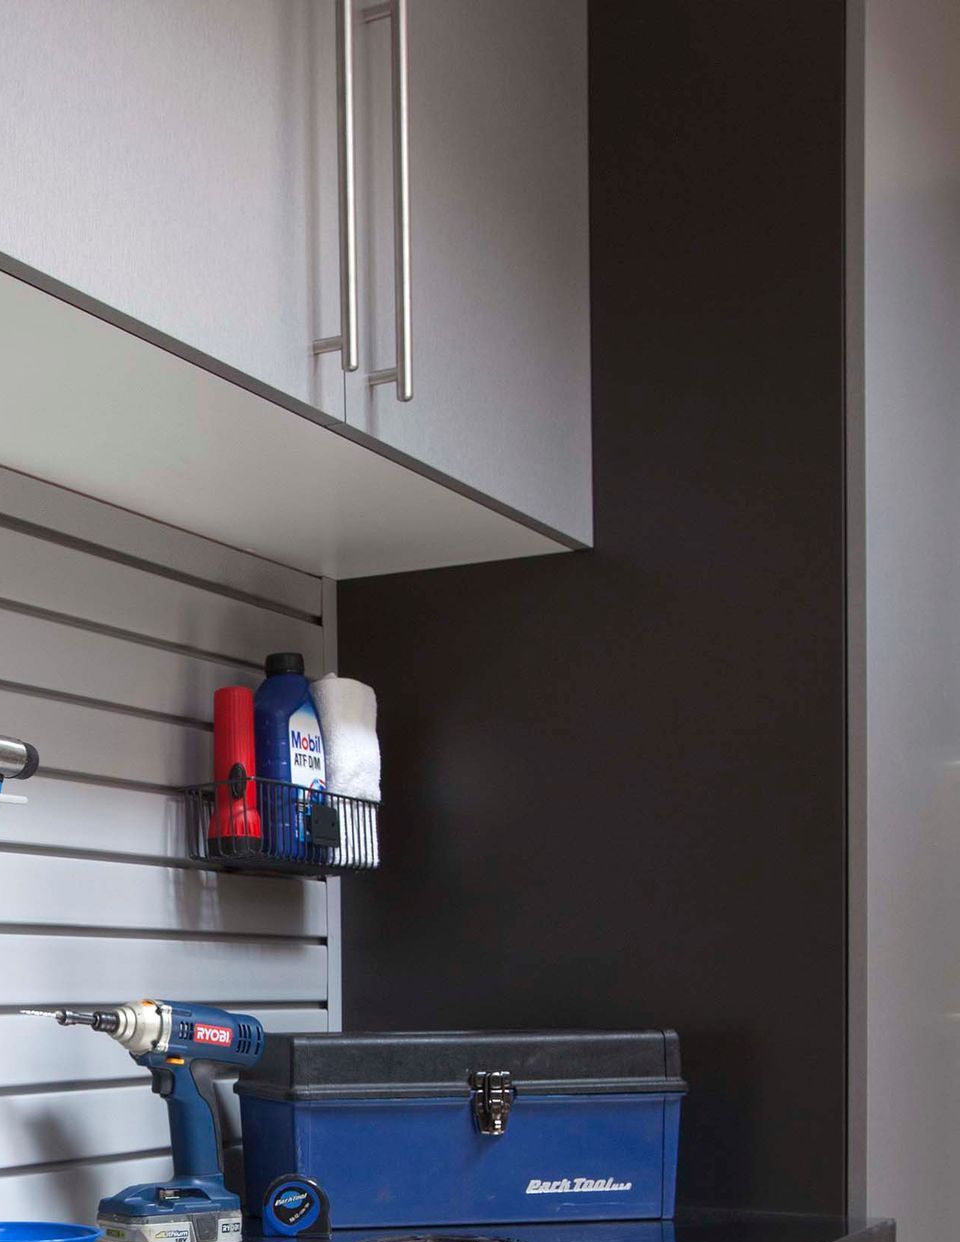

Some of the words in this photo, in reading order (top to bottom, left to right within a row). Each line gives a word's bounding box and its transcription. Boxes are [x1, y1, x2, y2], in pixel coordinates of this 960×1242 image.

[291, 729, 321, 753] Mobil
[294, 753, 308, 767] ATF
[196, 1026, 230, 1043] RYOBI
[525, 1178, 571, 1194] Park
[573, 1177, 614, 1192] Tool
